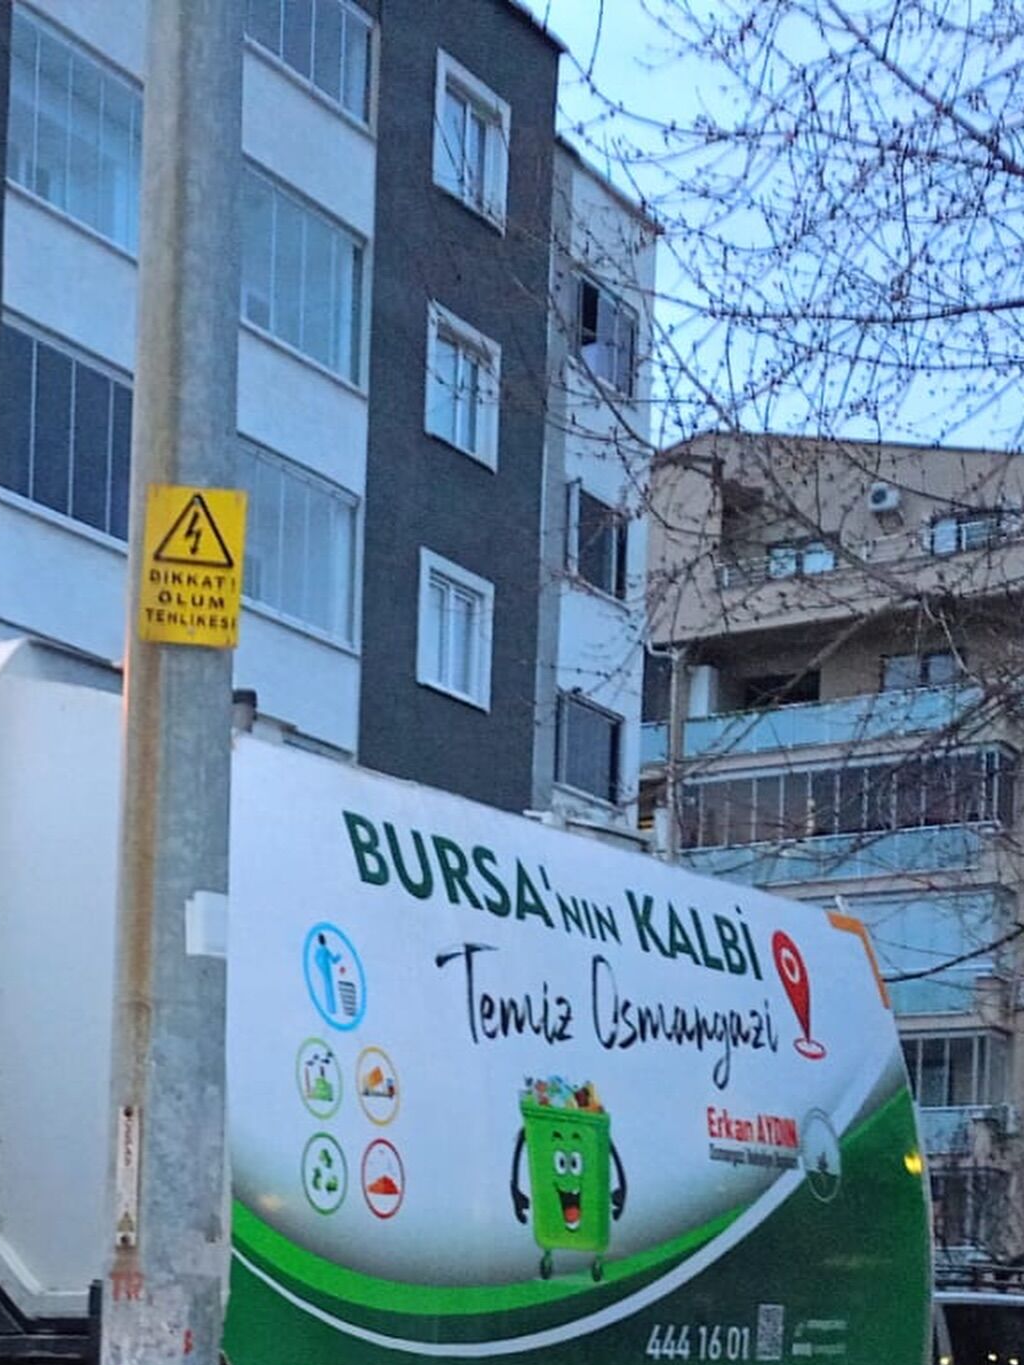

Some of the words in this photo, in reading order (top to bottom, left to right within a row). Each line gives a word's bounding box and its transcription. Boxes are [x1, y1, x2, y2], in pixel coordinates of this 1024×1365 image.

[625, 888, 764, 980] KALBİ
[435, 942, 574, 1047] Temiz
[592, 954, 780, 1090] Osmangazi
[706, 1105, 754, 1142] Erkan
[645, 1323, 691, 1361] 444
[698, 1324, 722, 1361] 16
[726, 1325, 751, 1361] 01
